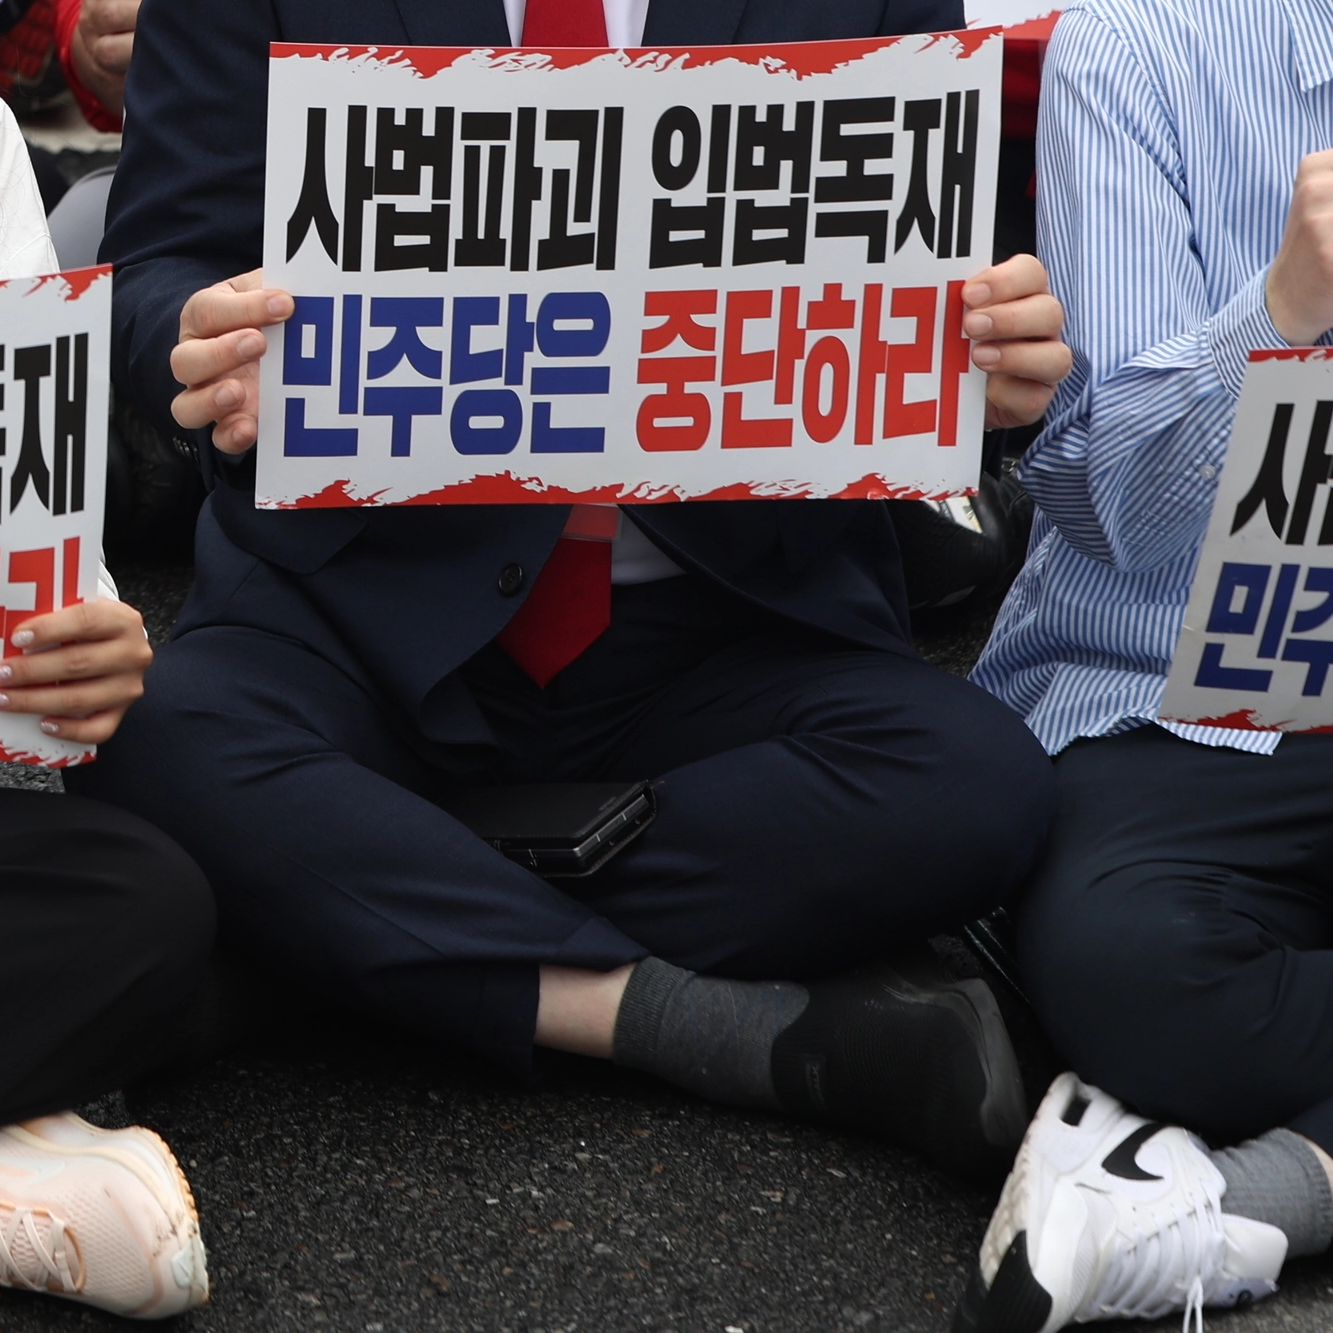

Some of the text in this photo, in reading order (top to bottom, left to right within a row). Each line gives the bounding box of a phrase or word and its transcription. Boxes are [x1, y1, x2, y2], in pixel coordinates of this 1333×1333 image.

[286, 89, 981, 272] 사법파괴 입법독재
[281, 279, 970, 458] 민주당은 중단하라
